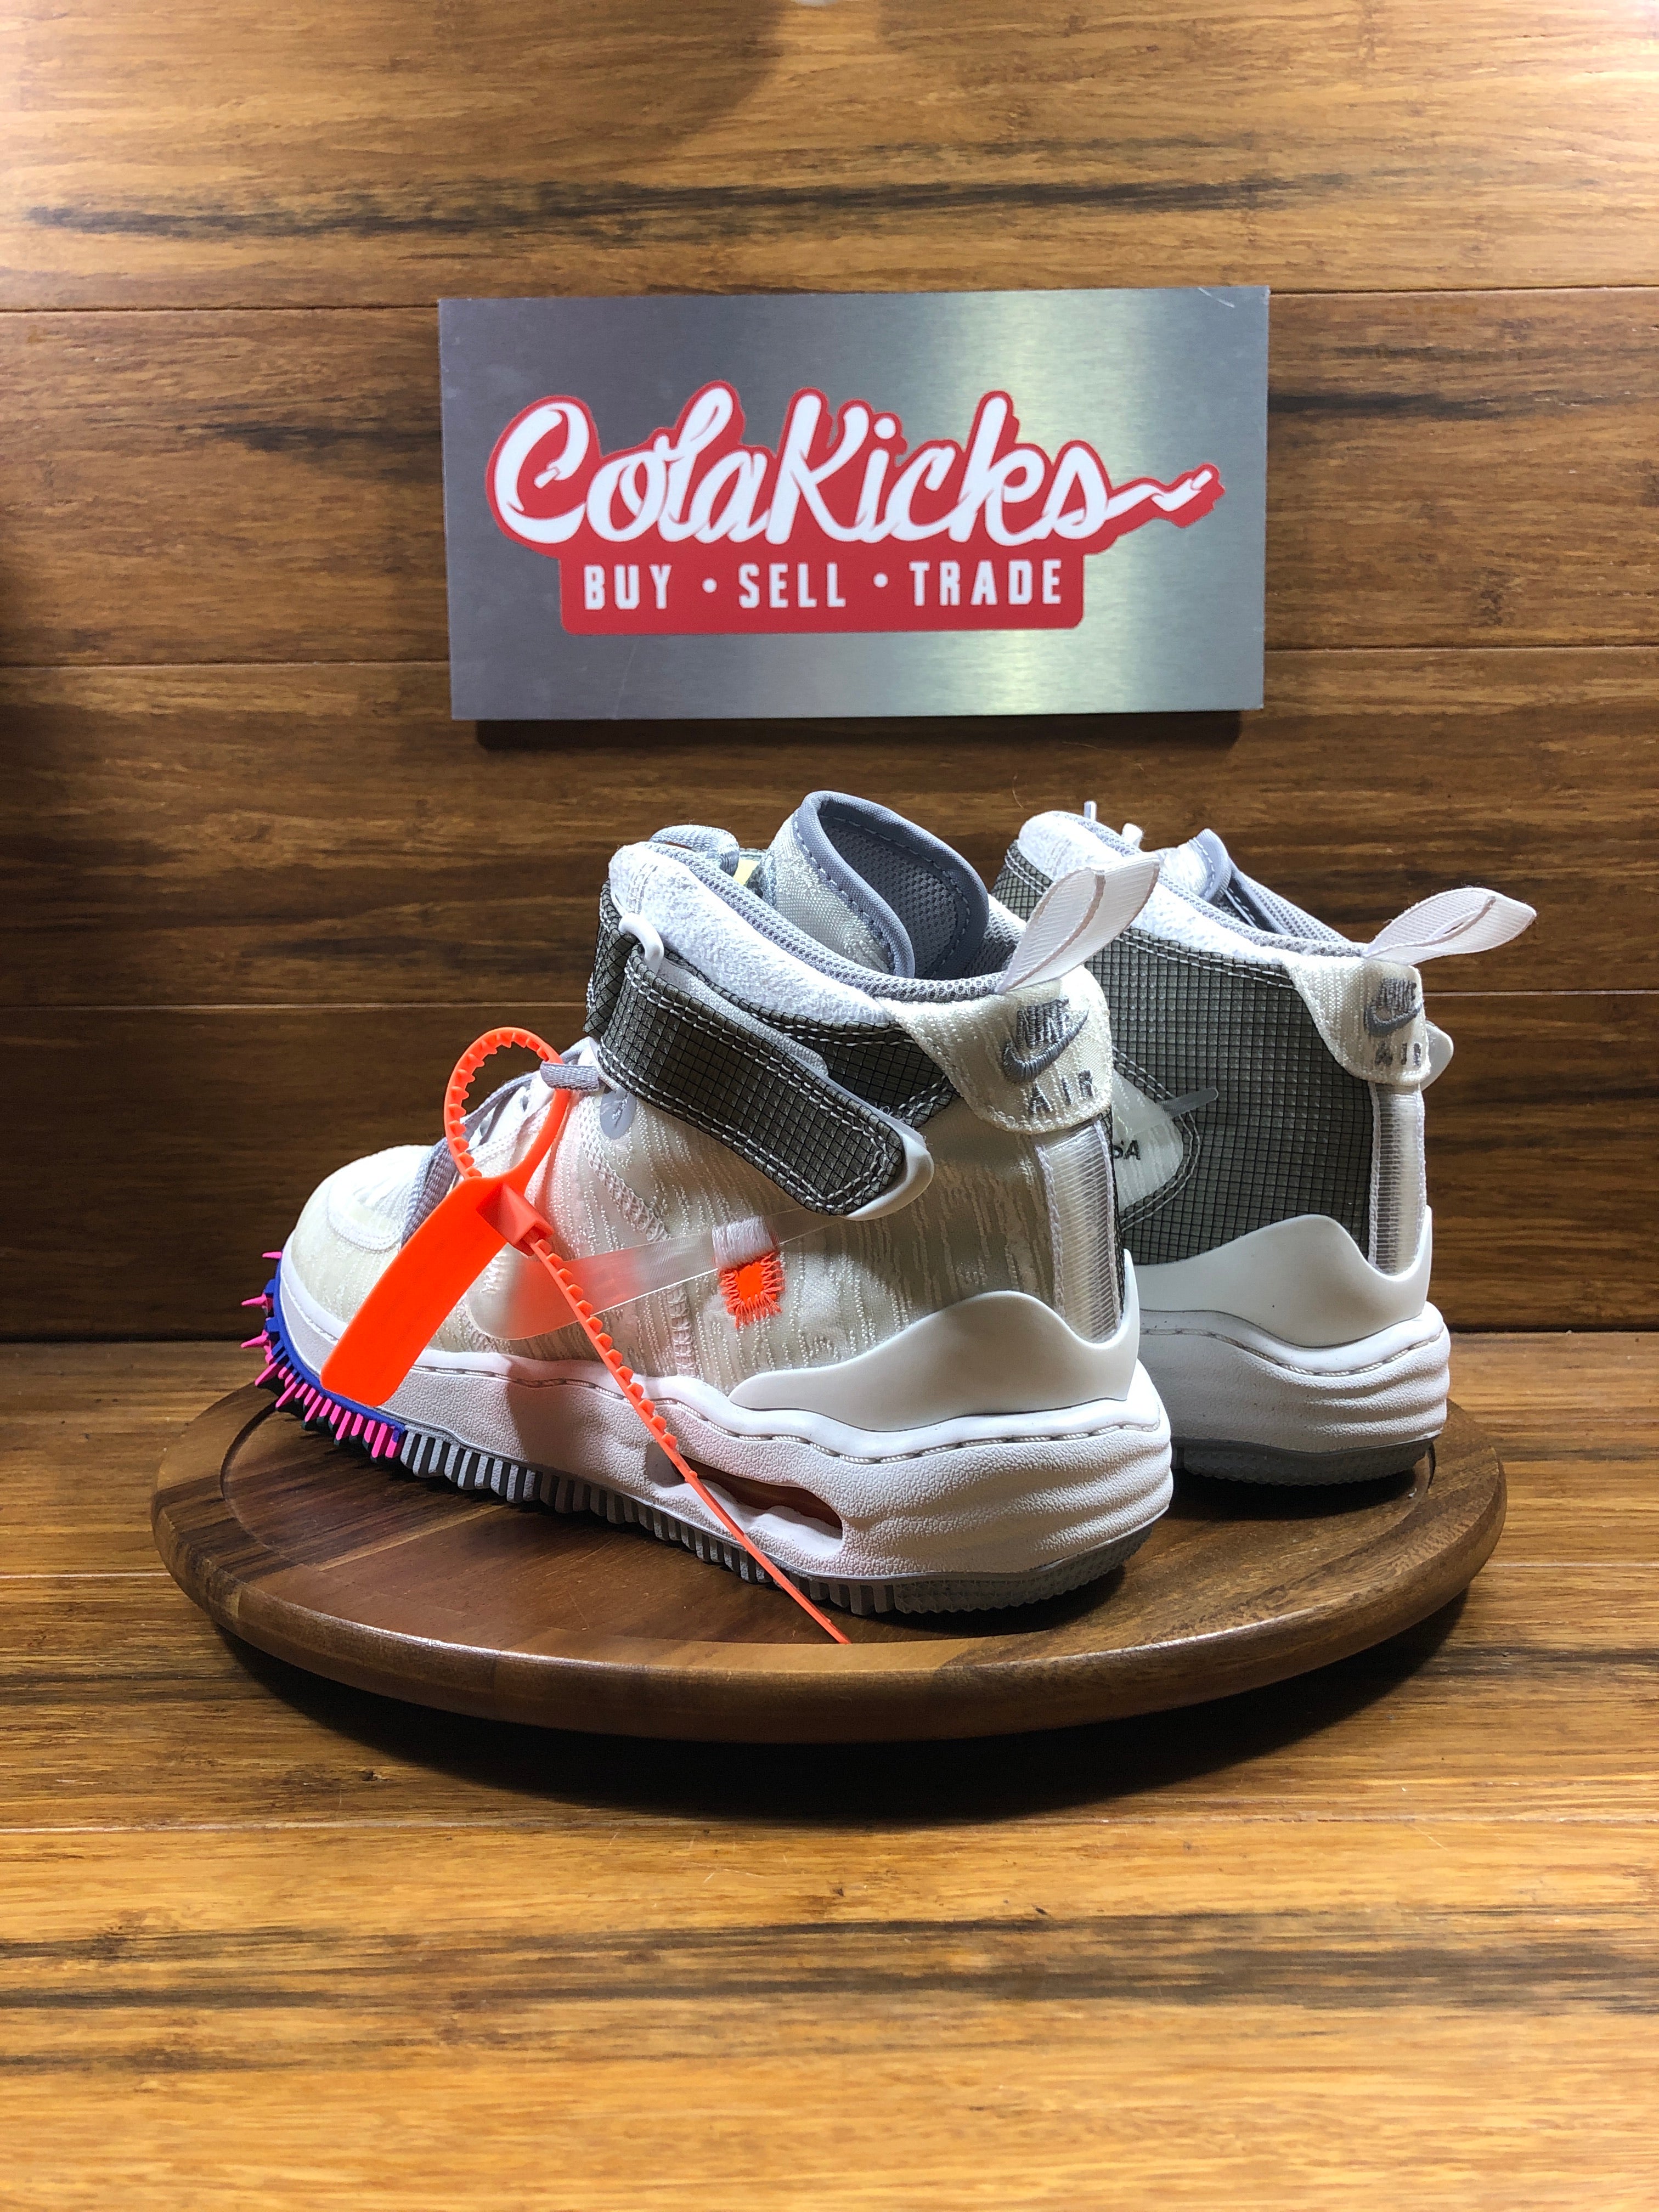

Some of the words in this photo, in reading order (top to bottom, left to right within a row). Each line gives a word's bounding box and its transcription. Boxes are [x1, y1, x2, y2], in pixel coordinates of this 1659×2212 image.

[496, 387, 1212, 545] ColaKicks
[584, 564, 672, 610] BUY
[739, 562, 846, 608] SELL
[910, 559, 1062, 606] TRADE
[1028, 1070, 1094, 1115] AIR
